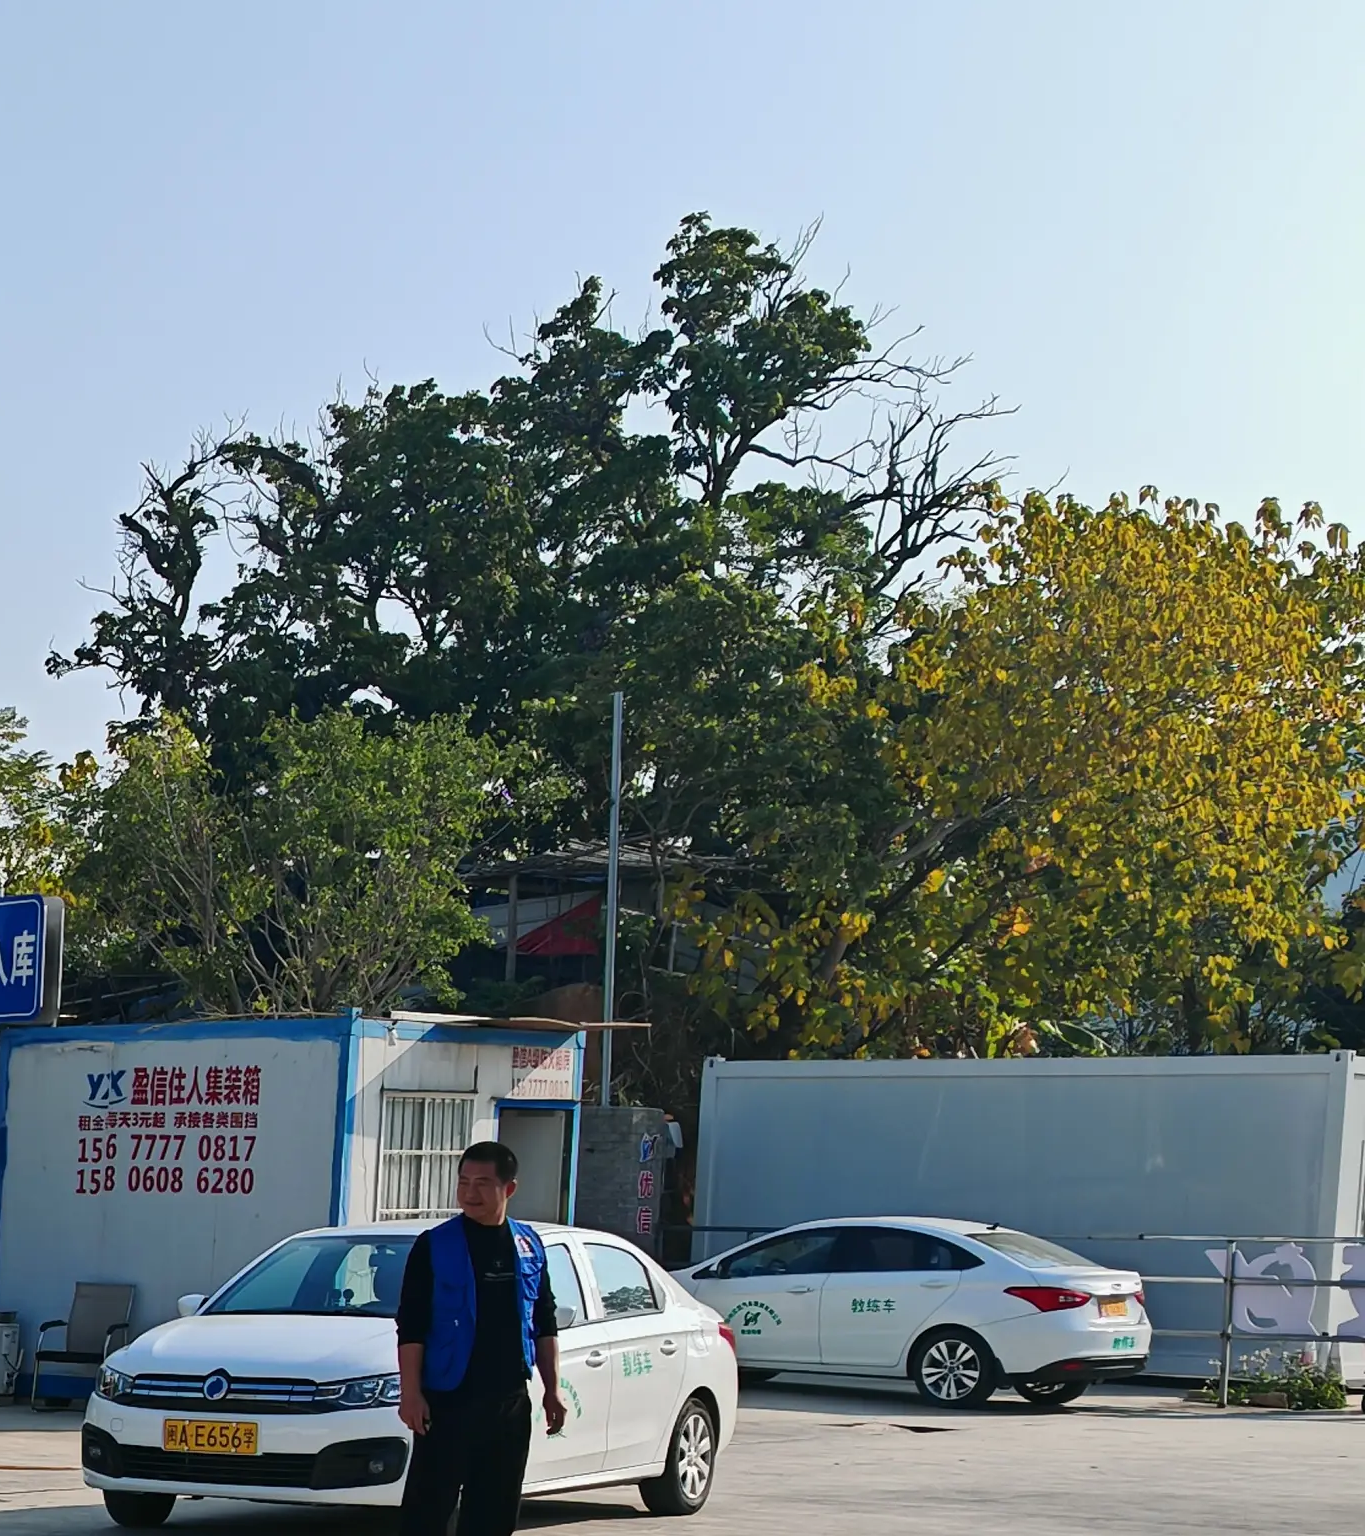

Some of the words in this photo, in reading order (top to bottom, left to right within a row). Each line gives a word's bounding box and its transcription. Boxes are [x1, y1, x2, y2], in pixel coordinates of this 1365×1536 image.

[130, 1065, 262, 1107] 盈信住人集装箱
[78, 1111, 166, 1131] 租金每天3元起
[174, 1111, 258, 1129] 承接各类围挡
[77, 1133, 117, 1164] 156
[130, 1134, 187, 1161] 7777
[198, 1134, 257, 1162] 0817
[75, 1165, 116, 1195] 158
[128, 1165, 184, 1193] 0608
[196, 1166, 255, 1195] 6280
[637, 1170, 653, 1234] 优信
[851, 1298, 896, 1314] 教练车
